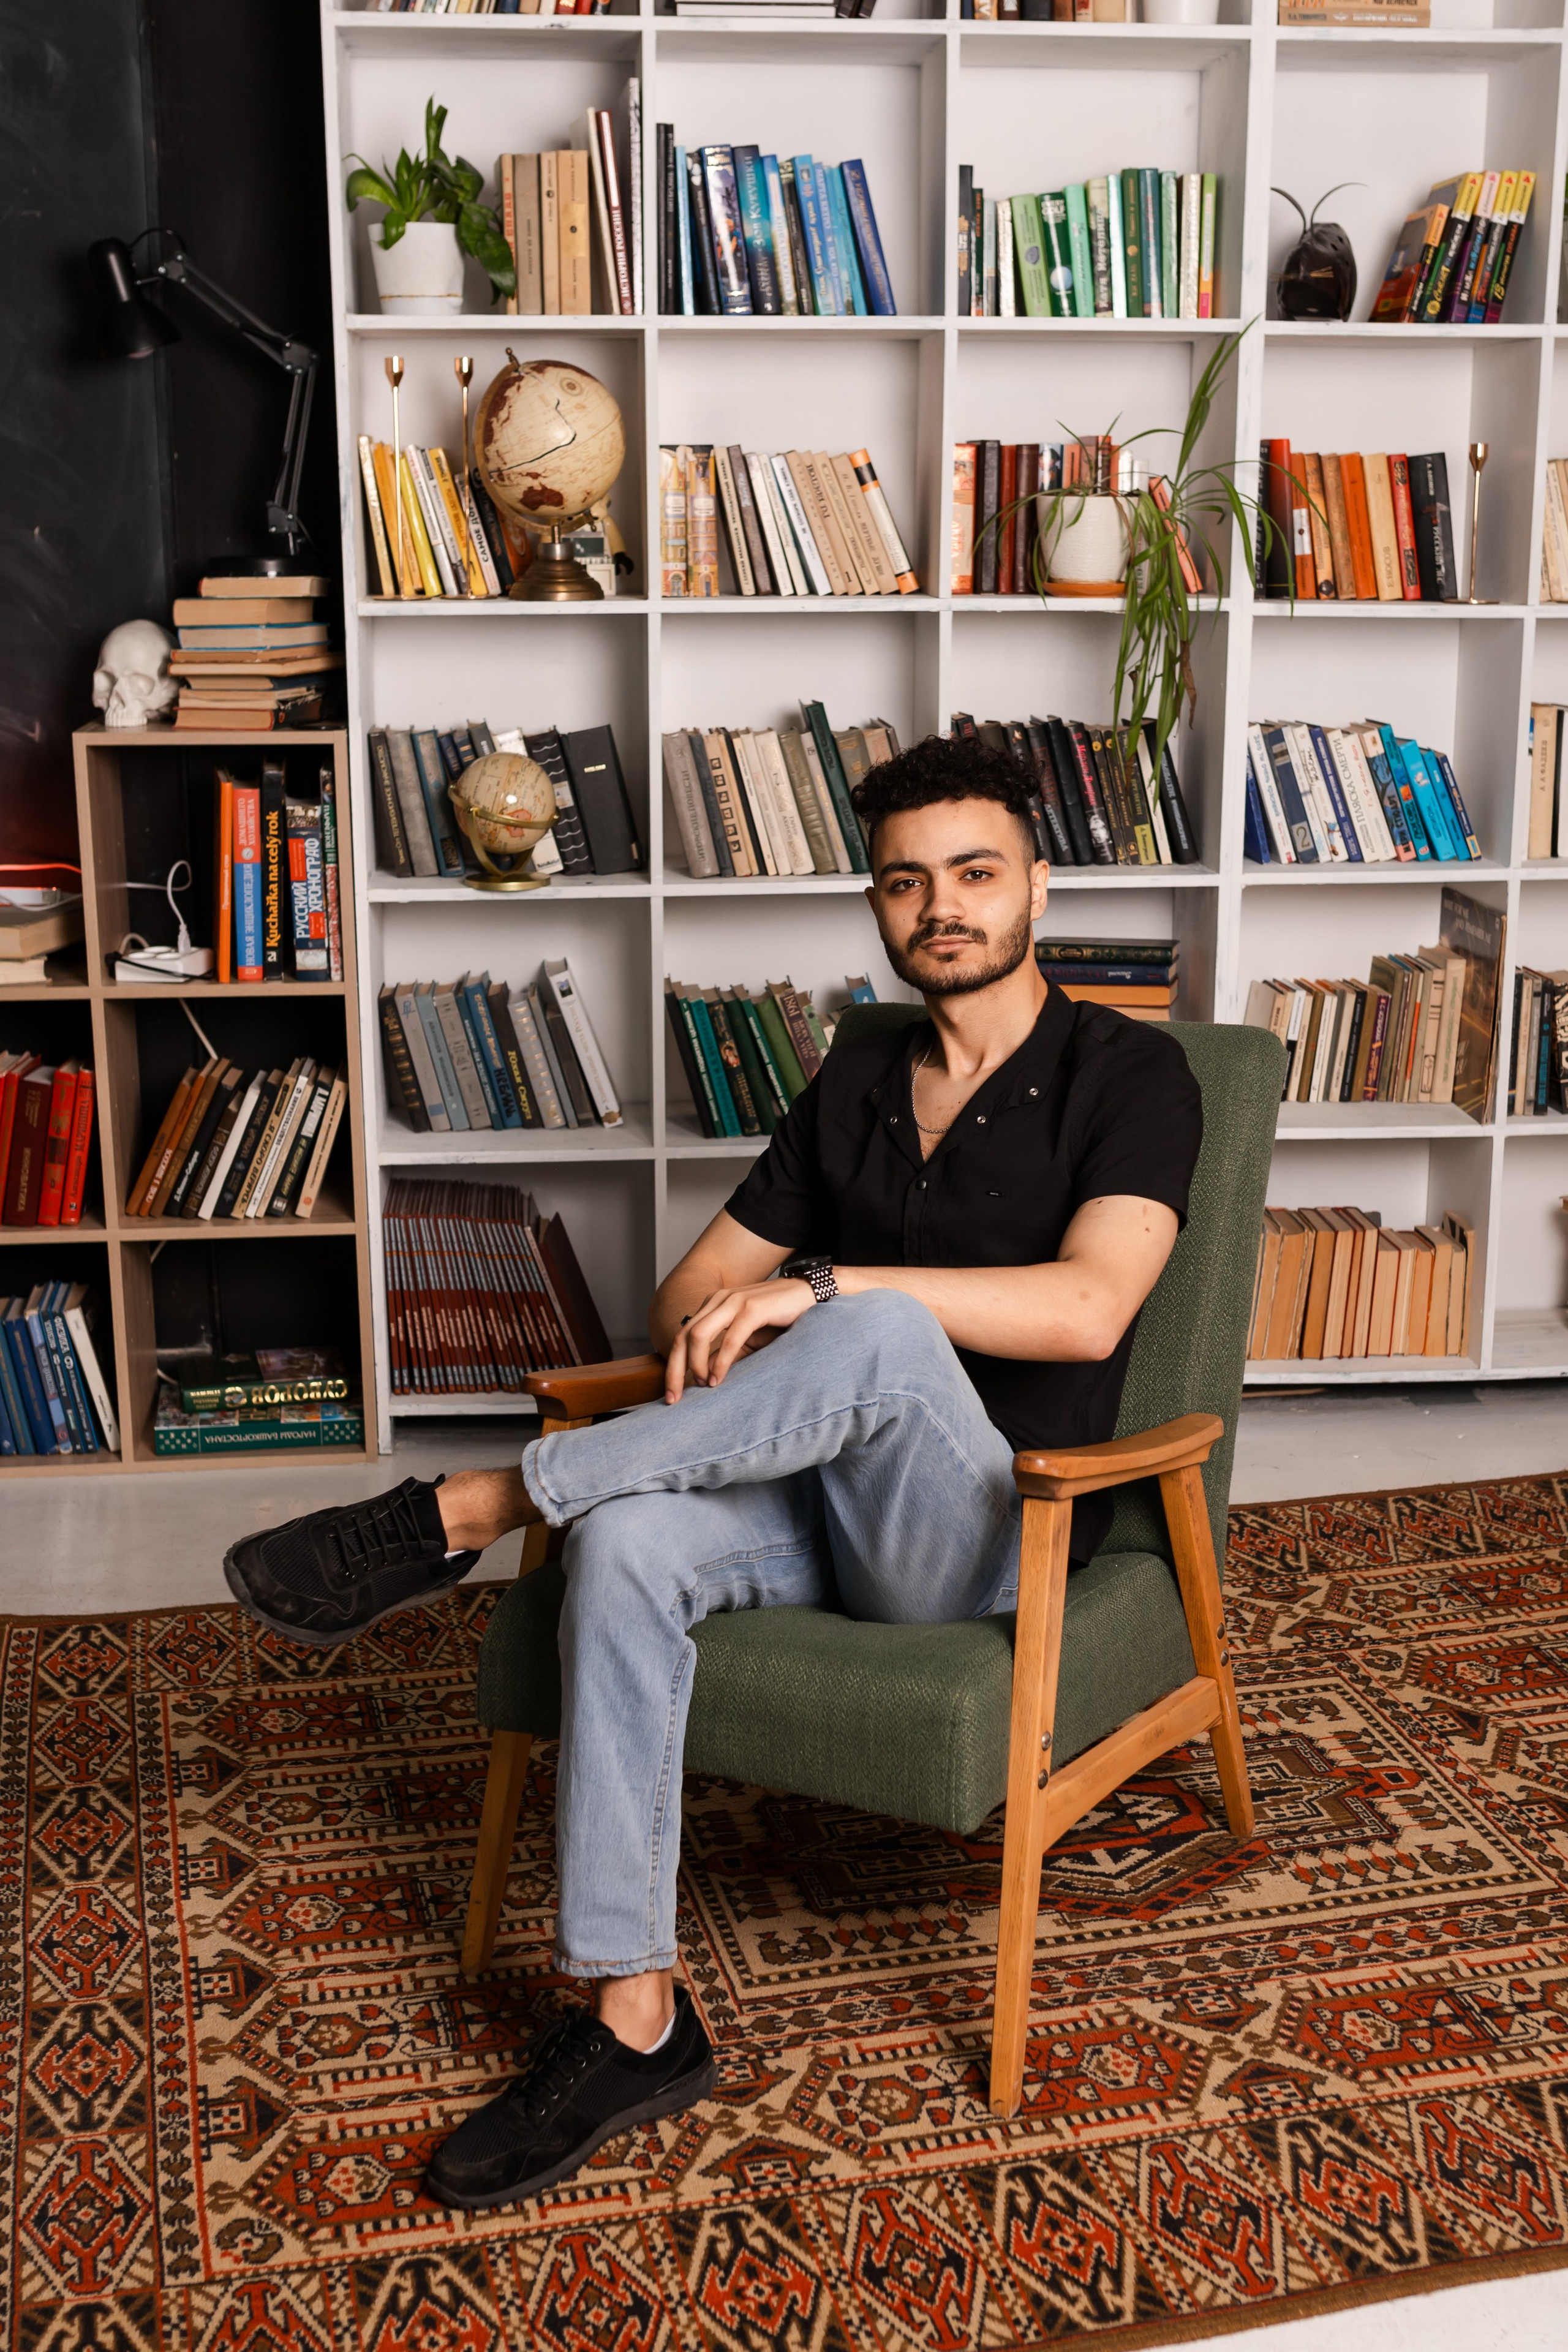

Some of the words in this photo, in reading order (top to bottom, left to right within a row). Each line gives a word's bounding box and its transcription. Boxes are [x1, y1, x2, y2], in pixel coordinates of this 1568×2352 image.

[611, 209, 625, 249] РОССИИ
[616, 251, 630, 297] ИСТОРИЯ
[1096, 276, 1111, 308] Катя
[472, 527, 489, 563] САМОЕ
[1072, 742, 1091, 775] Марлен
[1253, 733, 1264, 751] Зато
[1257, 752, 1265, 762] ты
[1332, 737, 1352, 780] СМЕРТИ
[1260, 763, 1271, 783] очень
[680, 769, 695, 812] ПОВЕСТИ
[1079, 772, 1099, 808] Дитрих
[1265, 784, 1281, 818] красивый
[1345, 780, 1365, 823] ПЛЯСКА
[266, 811, 279, 835] rok
[1042, 802, 1069, 852] ДЕТЕКТИВА
[1384, 793, 1406, 829] СТЮАРТ
[268, 835, 282, 864] celý
[1296, 825, 1313, 851] 2
[1396, 829, 1413, 854] МЕРИ
[270, 864, 279, 881] na
[304, 837, 323, 913] ХРОНОГРАФ
[243, 864, 255, 935] ЭНЦИКЛОПЕДИЯ
[266, 883, 281, 947] Kuchařka
[292, 882, 309, 939] РУССКИЙ
[245, 936, 255, 967] НОВАЯ
[782, 993, 801, 1017] 1861
[684, 1009, 697, 1038] ЦЕЛИНА
[506, 1048, 524, 1084] Юхан
[690, 1037, 706, 1073] ПОДНЯТАЯ
[765, 1063, 784, 1098] ПОДНЯТАЯ
[254, 1133, 273, 1166] СКОРО
[249, 1378, 348, 1407] СУВОРОВ
[203, 1430, 278, 1444] БАШКОРТОСТАНА
[279, 1429, 317, 1440] НАРОДЫ
